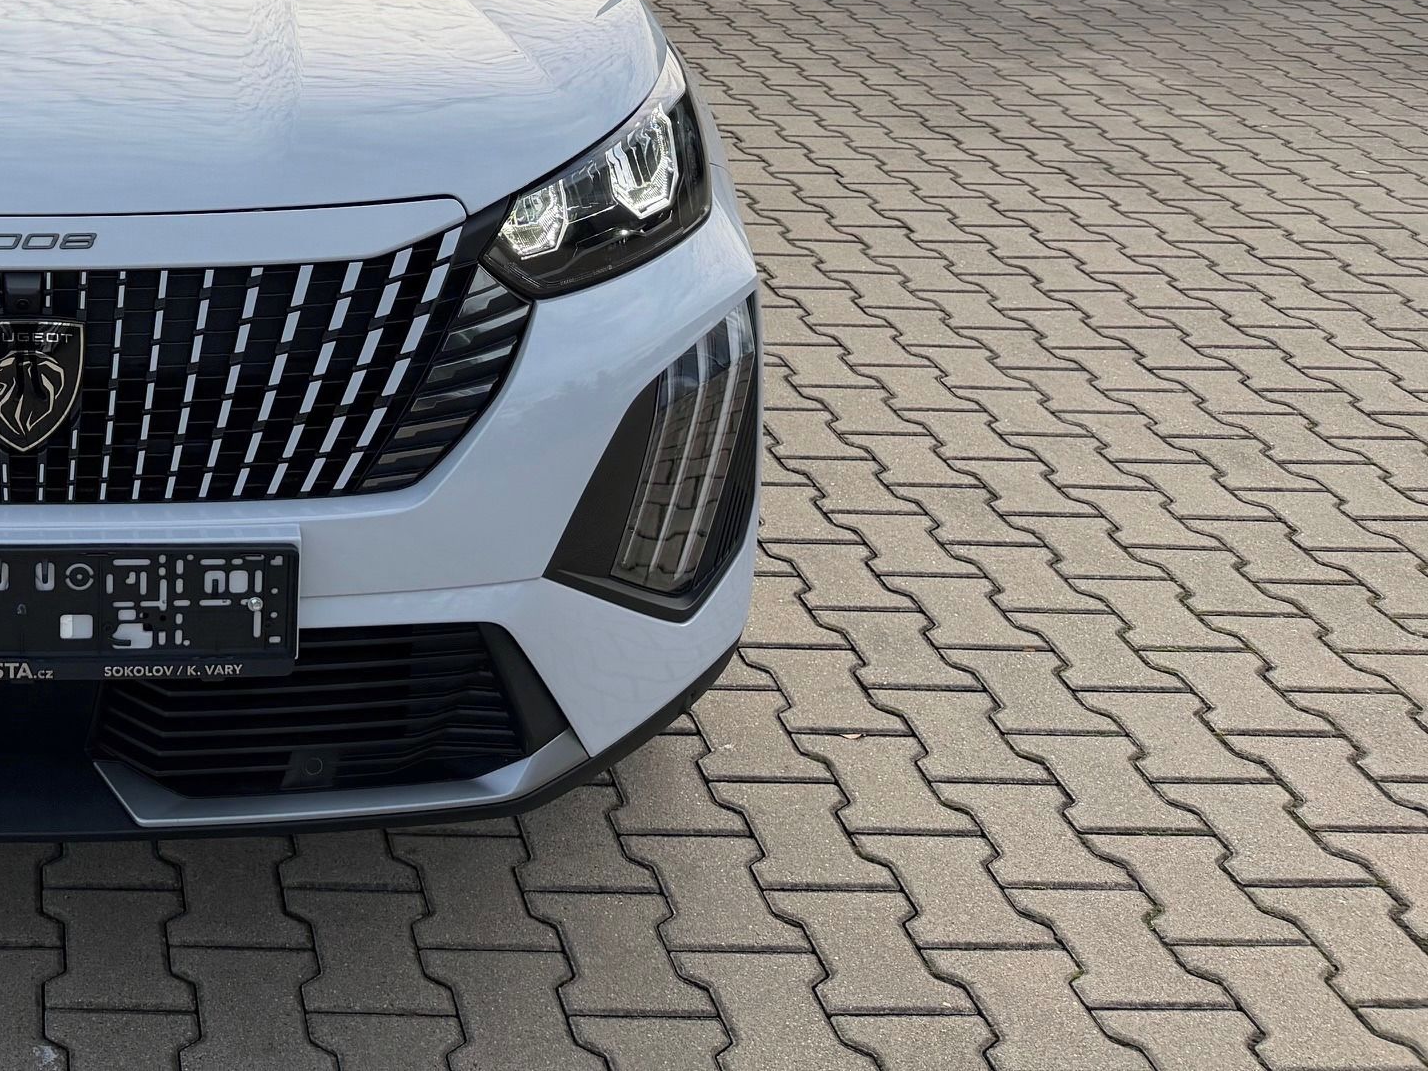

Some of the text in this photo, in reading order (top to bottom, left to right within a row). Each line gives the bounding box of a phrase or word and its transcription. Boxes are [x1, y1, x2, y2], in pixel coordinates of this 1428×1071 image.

[104, 665, 174, 677] SOKOLOV
[187, 665, 202, 676] K.
[206, 664, 243, 676] VARY
